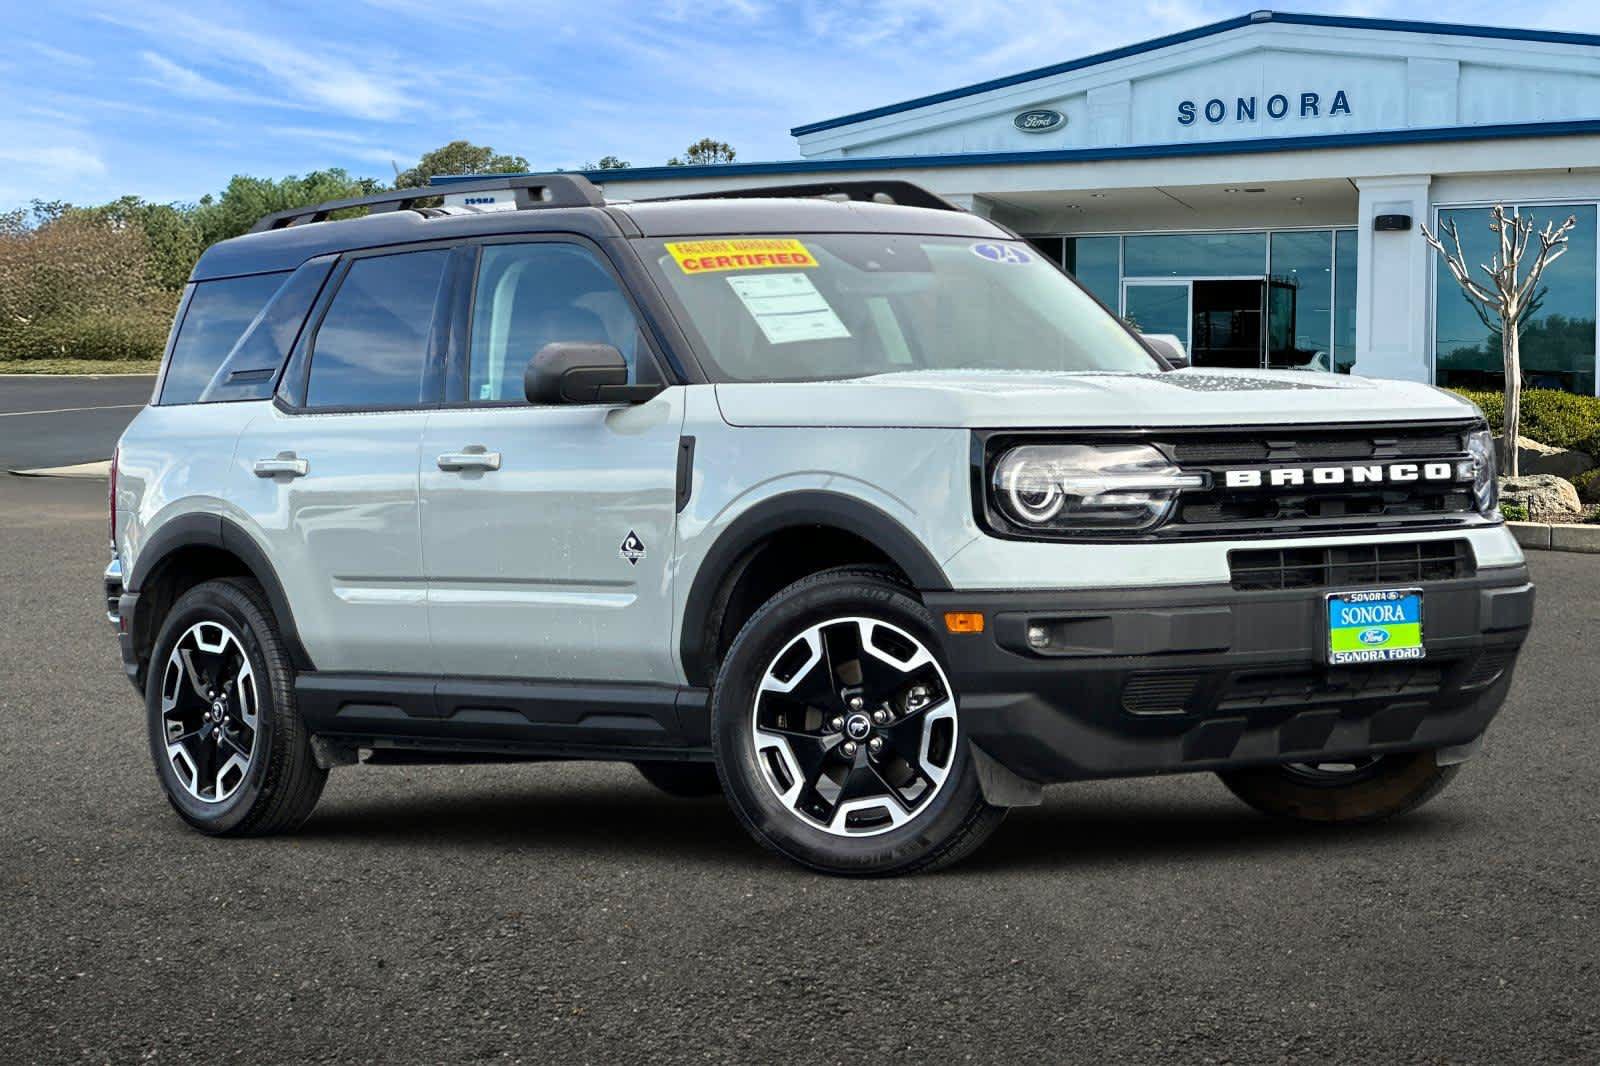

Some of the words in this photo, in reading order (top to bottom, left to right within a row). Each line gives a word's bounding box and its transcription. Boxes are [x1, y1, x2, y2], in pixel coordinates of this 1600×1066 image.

[1177, 90, 1352, 126] SONORA
[682, 253, 809, 270] CERTIFIED
[1225, 463, 1451, 487] BRONCO
[1351, 592, 1387, 602] SONORA
[1341, 605, 1406, 625] SONORA
[1335, 651, 1386, 664] SONORA
[1389, 648, 1420, 660] FORD
